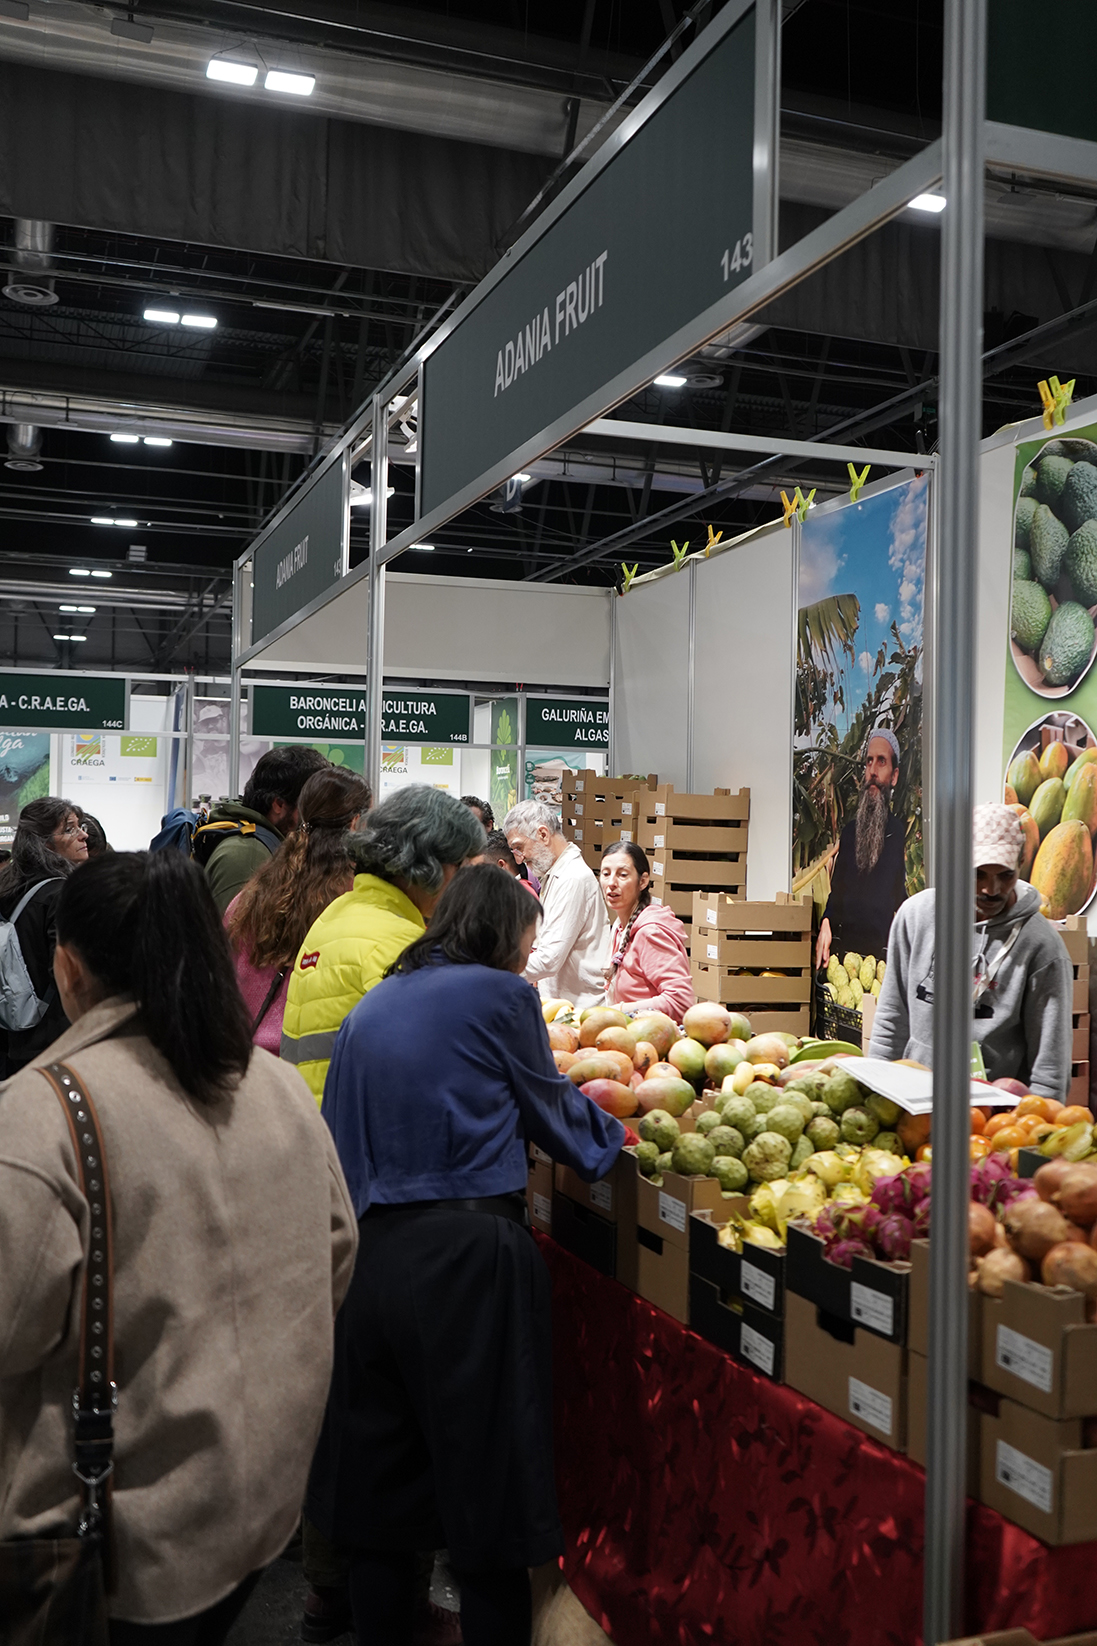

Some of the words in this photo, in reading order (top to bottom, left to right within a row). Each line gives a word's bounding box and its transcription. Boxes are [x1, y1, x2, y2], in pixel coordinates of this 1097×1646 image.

[720, 231, 753, 282] 143
[494, 306, 552, 398] ADANIA
[555, 250, 608, 345] FRUIT
[18, 695, 91, 712] C.R.A.E.GA.
[290, 696, 356, 712] BARONCELI
[358, 699, 437, 716] AICULTURA
[297, 713, 358, 731] ORGÁNICA
[541, 707, 595, 723] GALURIÑA
[102, 720, 123, 728] 144C
[574, 728, 609, 742] ALGAS
[70, 758, 105, 767] CRAEGA
